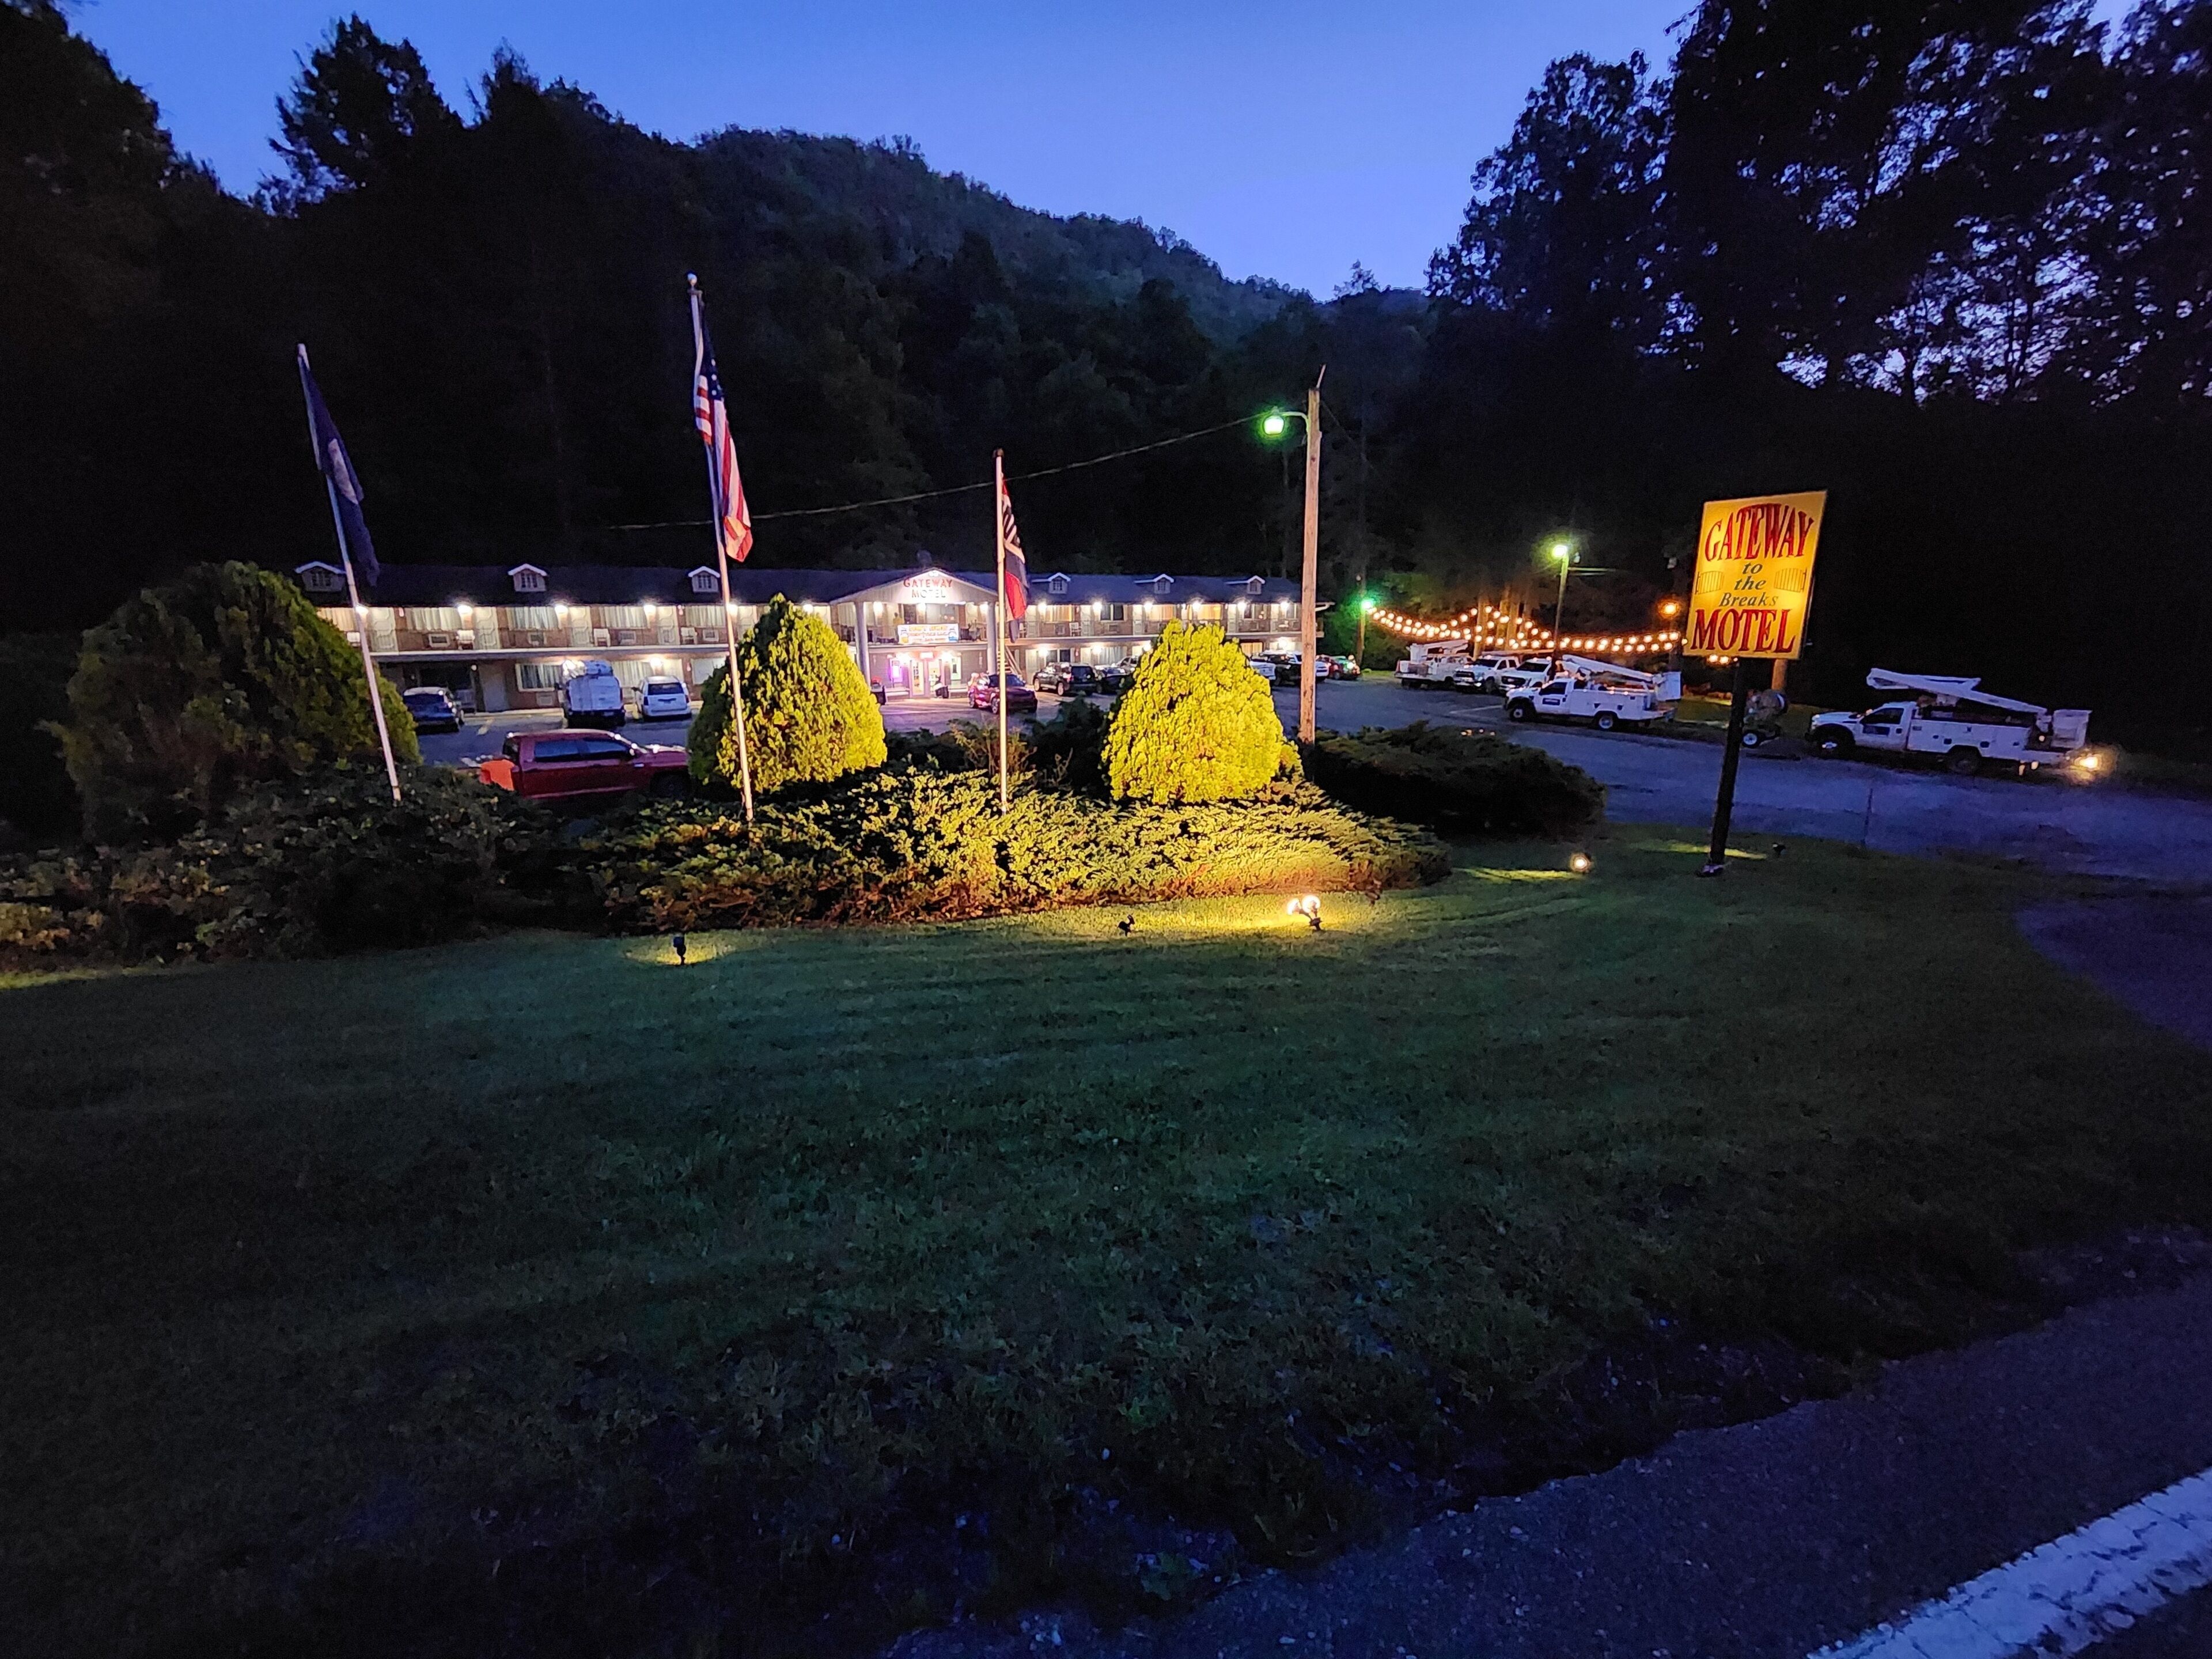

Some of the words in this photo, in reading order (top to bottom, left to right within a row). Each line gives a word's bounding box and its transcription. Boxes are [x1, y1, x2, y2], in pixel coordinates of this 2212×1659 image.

[1705, 503, 1815, 562] GATEWAY
[1742, 562, 1763, 574] to
[903, 578, 953, 588] GATEWAY
[1733, 576, 1767, 590] the
[1718, 592, 1778, 607] Breaks
[1690, 608, 1796, 653] MOTEL
